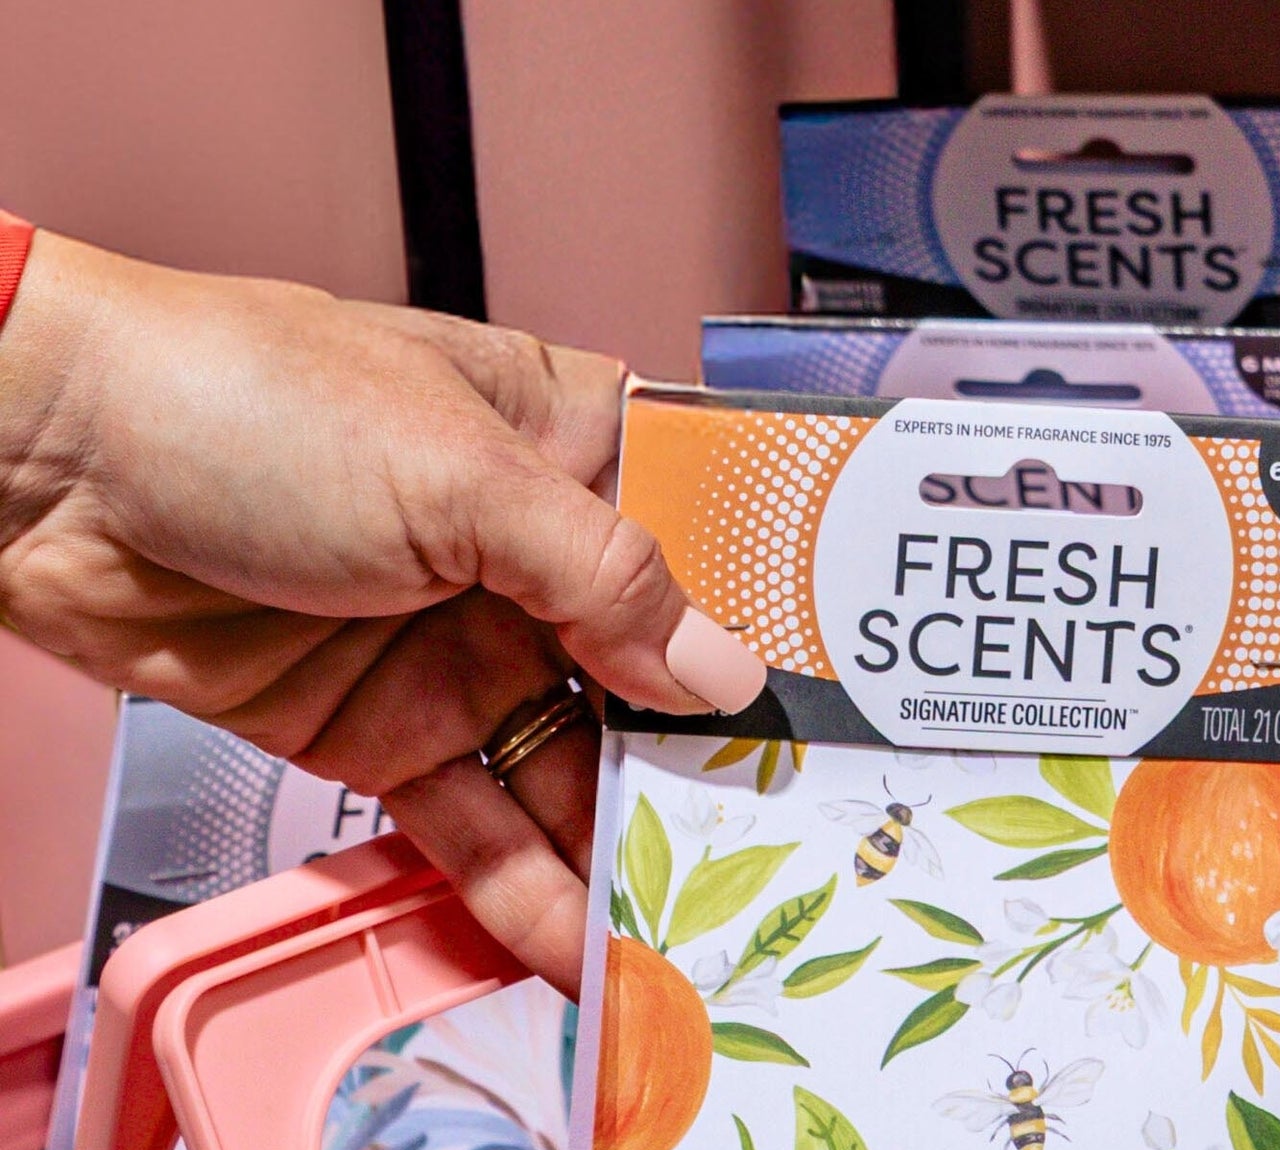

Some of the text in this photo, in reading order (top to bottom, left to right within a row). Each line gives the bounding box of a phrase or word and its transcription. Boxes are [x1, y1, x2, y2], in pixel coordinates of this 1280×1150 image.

[994, 186, 1213, 237] FRESH
[974, 236, 1240, 292] SCENTS
[1241, 355, 1260, 374] 6
[894, 419, 1171, 448] EXPERTS IN HOME FRAGRANCE SINCE 1975
[894, 532, 1160, 610] FRESH
[899, 697, 1007, 726] SIGNATURE
[1201, 706, 1249, 743] TOTAL
[1252, 709, 1271, 744] 21
